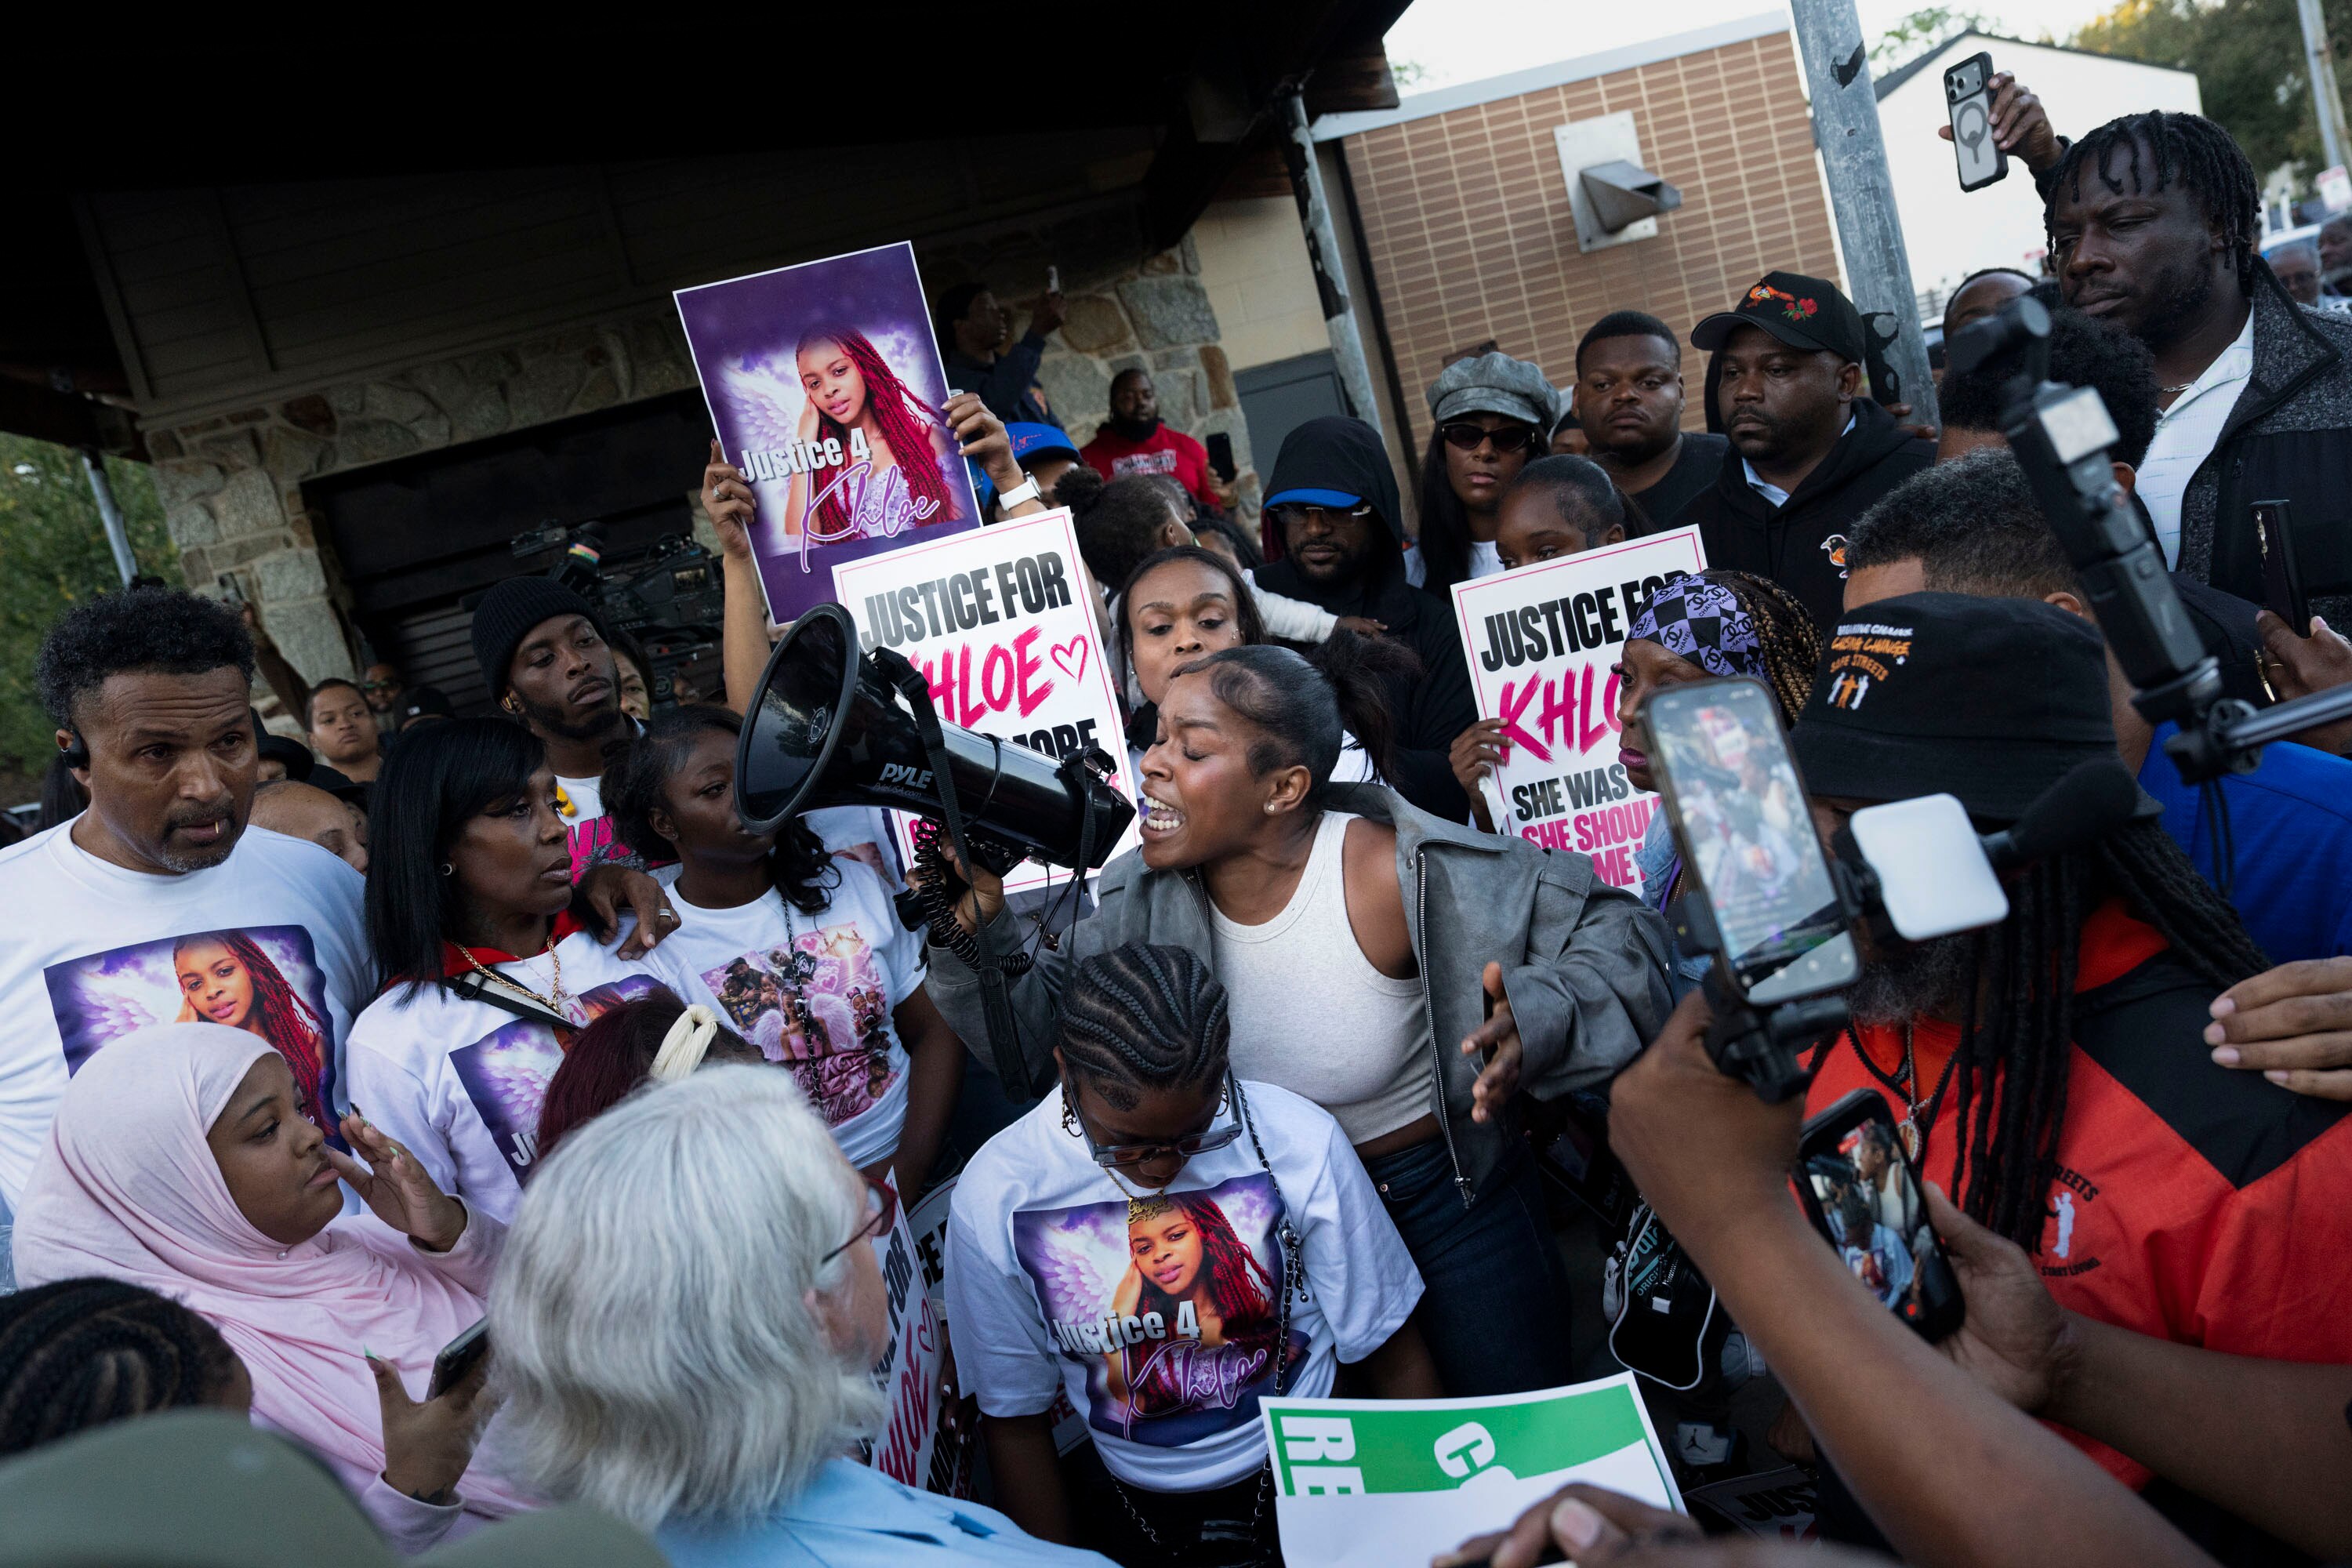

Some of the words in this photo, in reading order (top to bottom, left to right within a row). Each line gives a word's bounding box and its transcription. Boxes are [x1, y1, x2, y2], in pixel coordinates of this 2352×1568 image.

[739, 434, 844, 483] Justice
[850, 428, 871, 461] 4
[800, 461, 940, 574] Khloe
[861, 568, 999, 649] JUSTICE
[995, 551, 1073, 619] FOR
[1480, 588, 1624, 672] JUSTICE
[909, 624, 1055, 728] HLOE
[1512, 778, 1566, 822] SHE
[1563, 764, 1628, 810] WAS
[1522, 818, 1573, 852] SHE
[1573, 796, 1662, 851] SHOU
[2053, 1164, 2100, 1202] REETS
[1052, 1310, 1167, 1357] Justice
[1176, 1300, 1203, 1340] 4
[1122, 1339, 1268, 1442] Khloe
